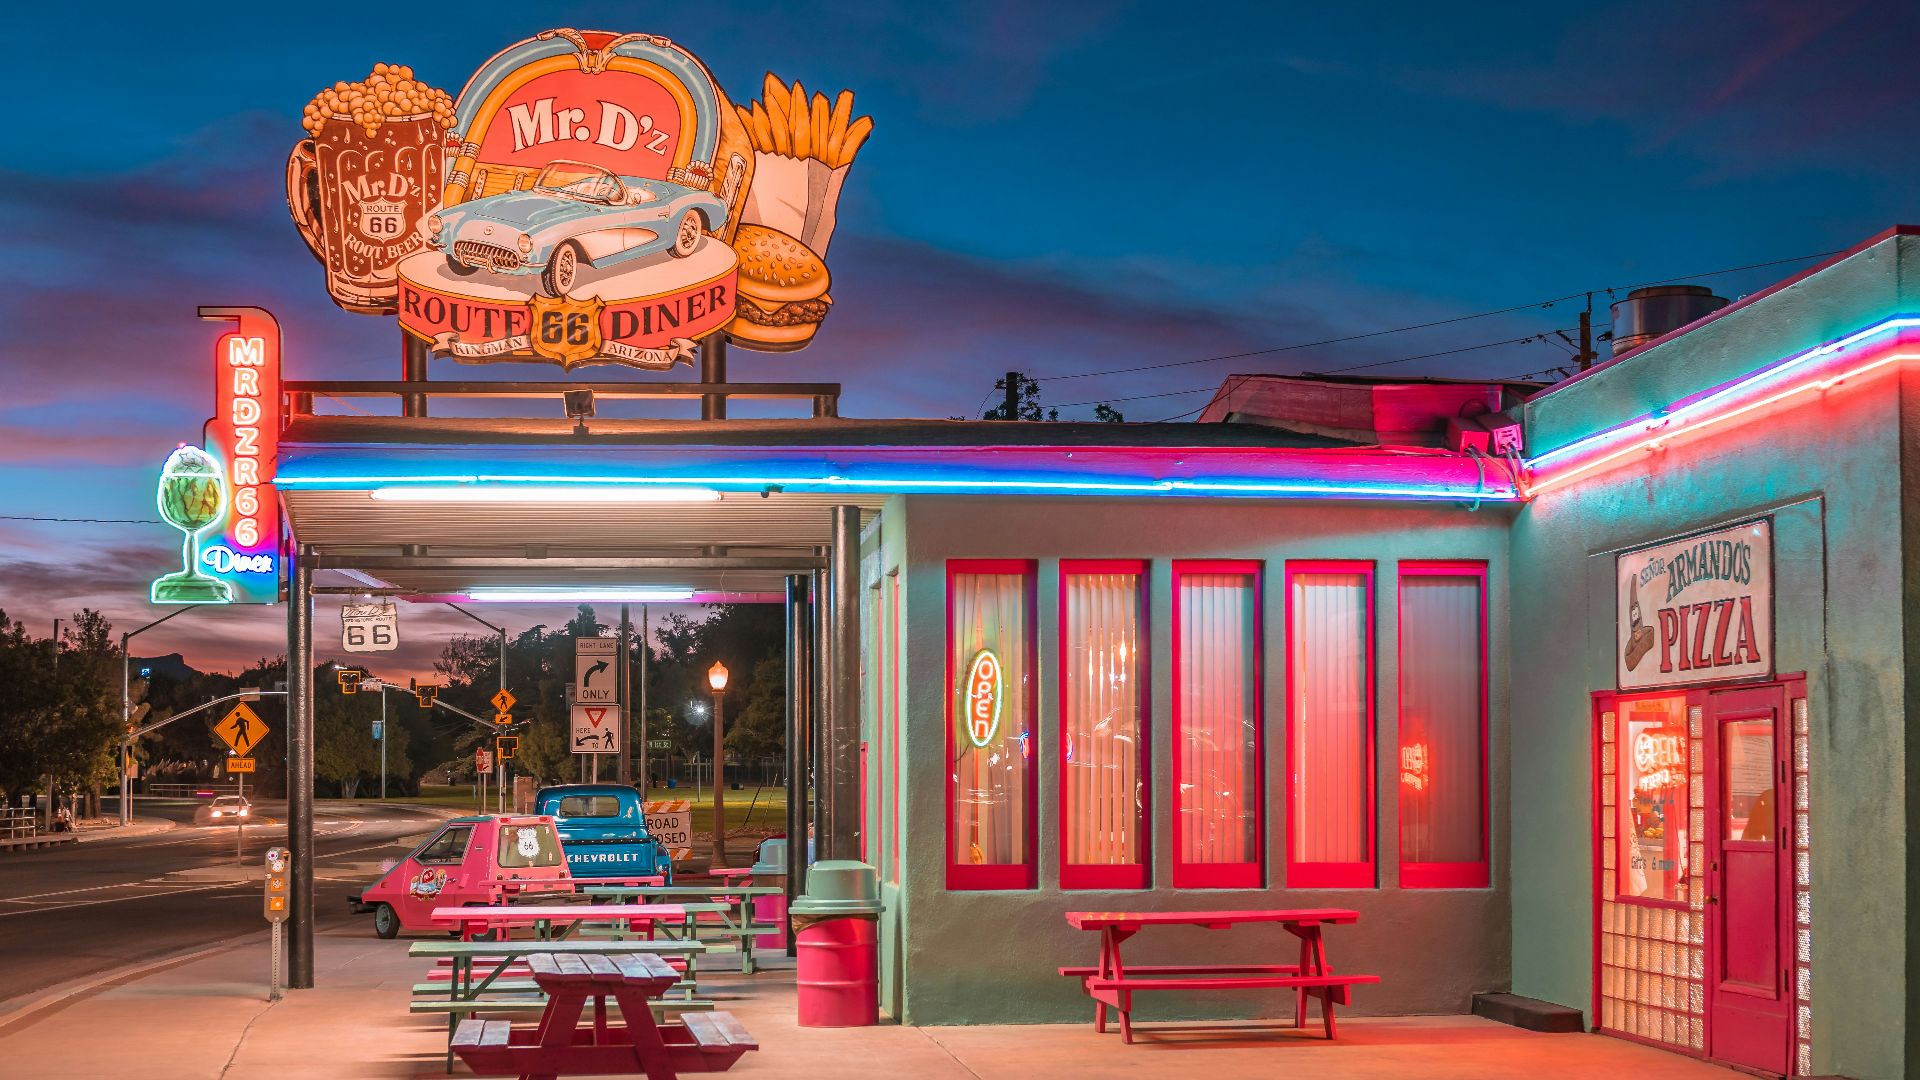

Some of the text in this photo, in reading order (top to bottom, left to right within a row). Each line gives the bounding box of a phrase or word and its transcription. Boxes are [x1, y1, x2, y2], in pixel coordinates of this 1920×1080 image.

[506, 97, 670, 156] Mr. D'z
[341, 174, 386, 205] Mr.
[366, 205, 400, 213] ROUTE
[369, 217, 397, 233] 66
[344, 231, 424, 259] ROOT BEER
[404, 284, 727, 346] ROUTE 66 DINER
[454, 337, 672, 363] KINGMAN ARIZONA
[202, 545, 273, 574] Diner
[1666, 540, 1752, 603] ARMANDO'S
[347, 625, 391, 645] 66
[1658, 596, 1760, 673] PIZZA
[582, 690, 609, 699] ONLY
[647, 817, 679, 829] ROAD
[651, 831, 687, 844] OSED
[567, 853, 639, 863] CHEVROLET
